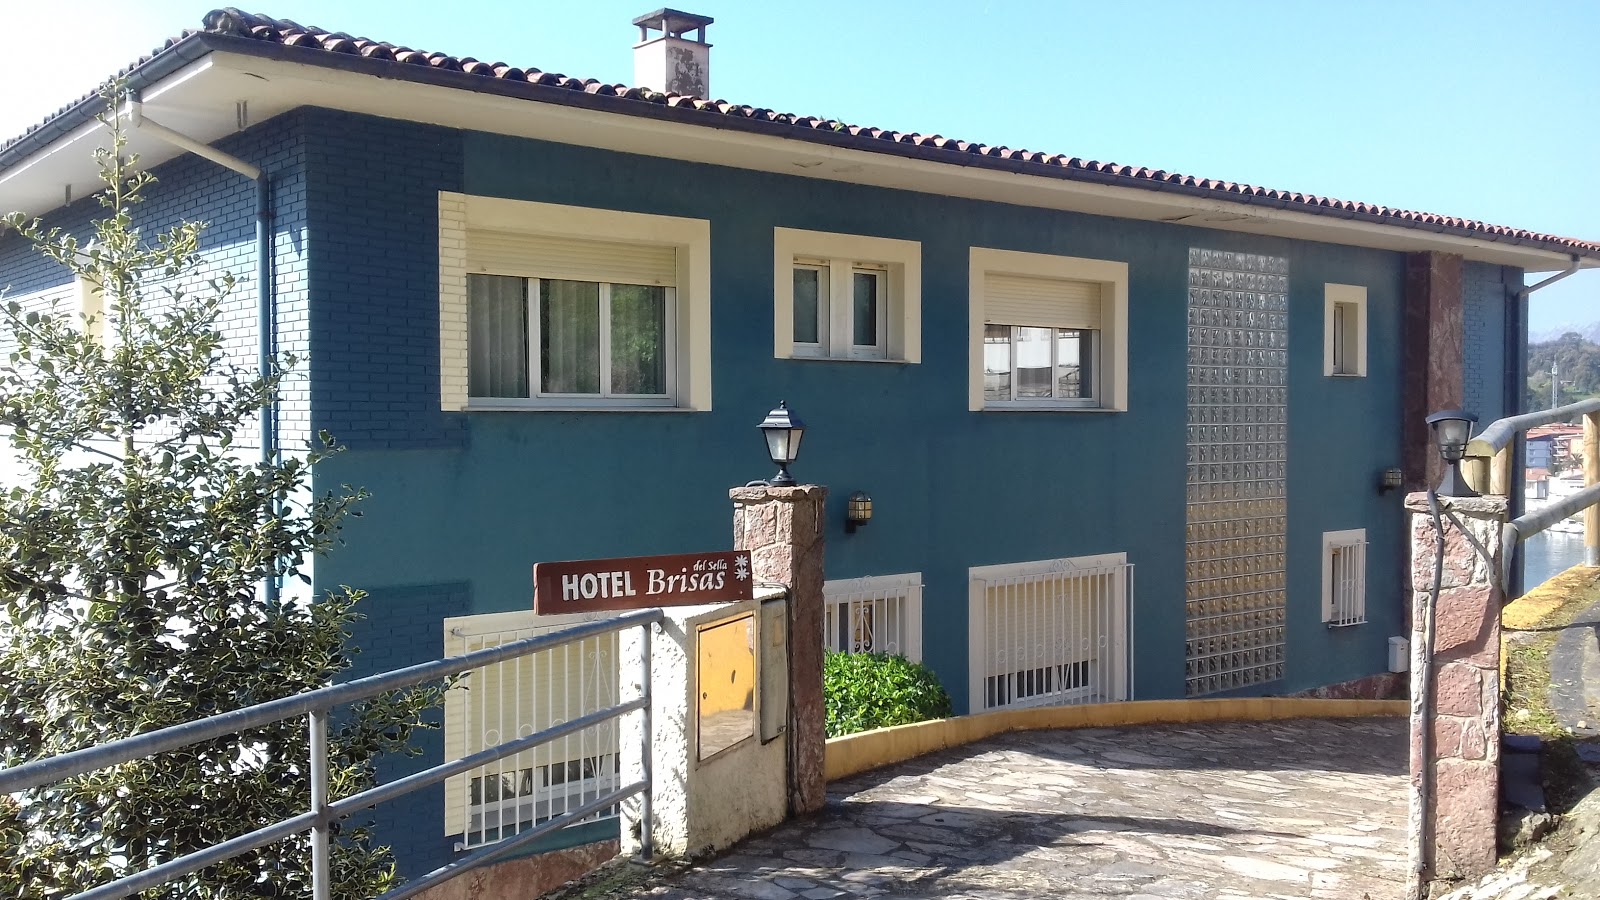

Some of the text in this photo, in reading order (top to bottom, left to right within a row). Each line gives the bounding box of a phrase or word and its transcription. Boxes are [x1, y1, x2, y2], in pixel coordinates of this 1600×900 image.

[693, 559, 727, 571] del Sella
[562, 567, 725, 601] HOTEL Brisas
